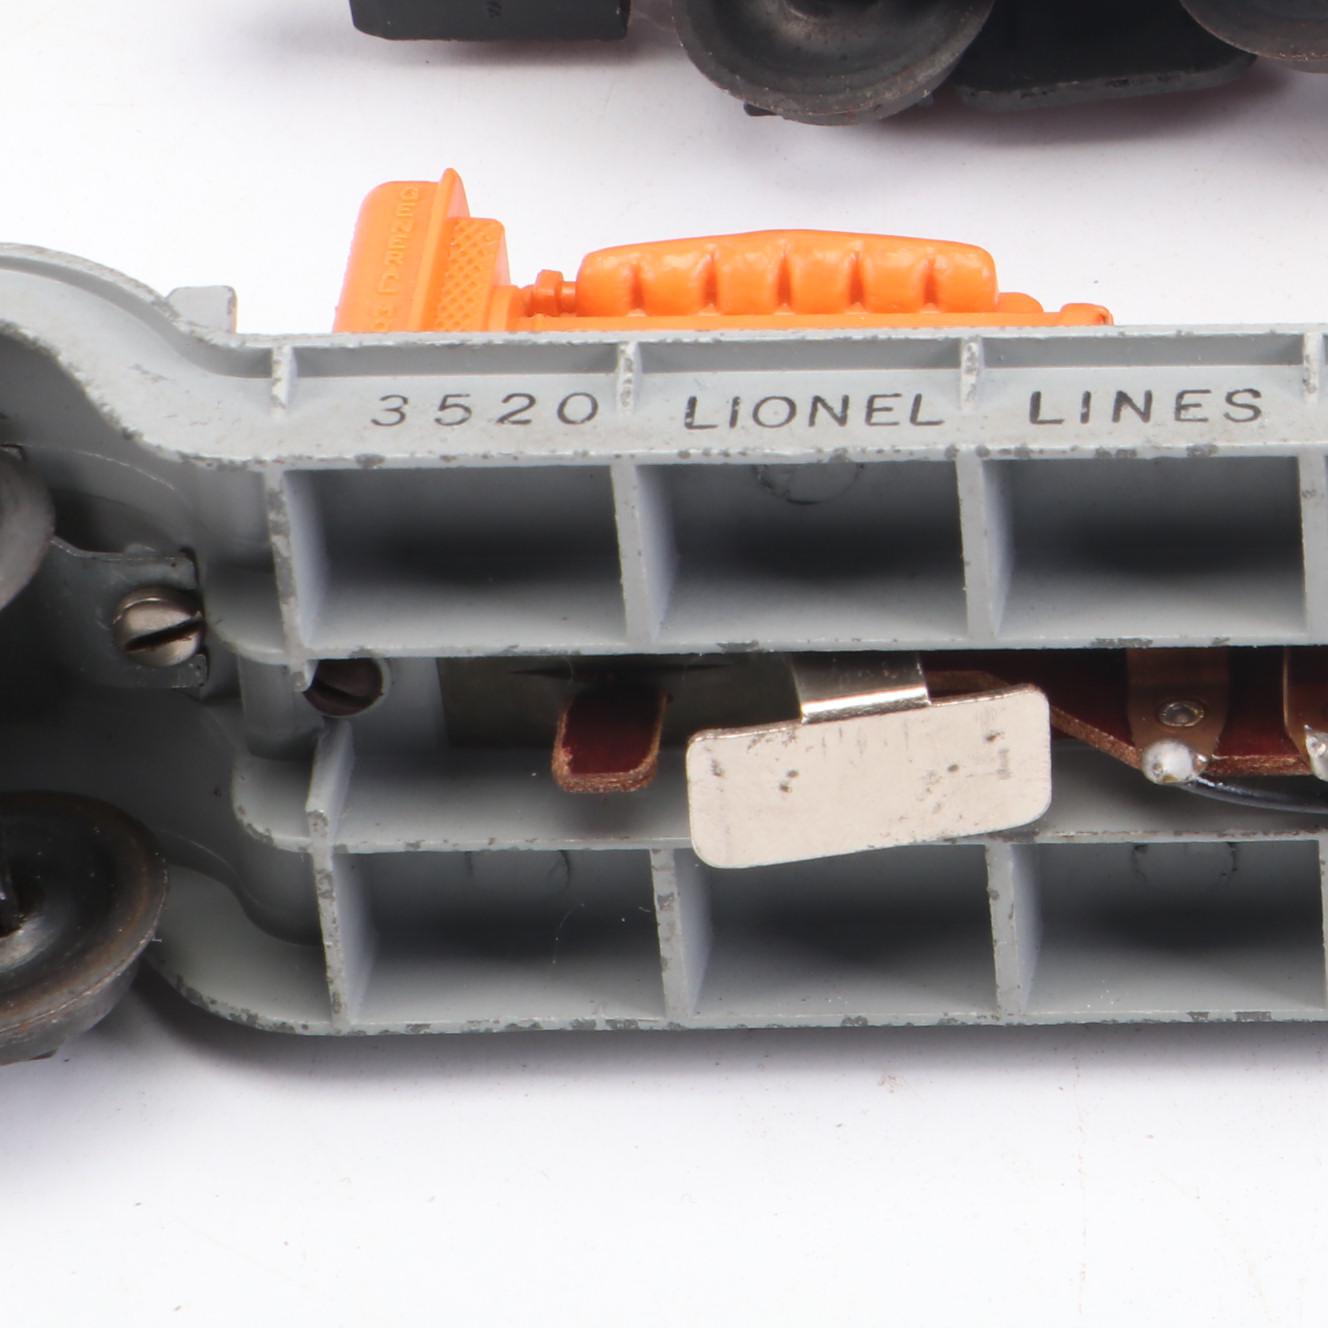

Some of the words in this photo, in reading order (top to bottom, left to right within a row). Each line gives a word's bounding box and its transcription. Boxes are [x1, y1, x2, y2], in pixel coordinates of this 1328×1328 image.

[376, 184, 421, 294] GENERAL
[372, 393, 598, 426] 3520
[684, 393, 942, 430] LIONEL
[1029, 388, 1262, 425] LINES
